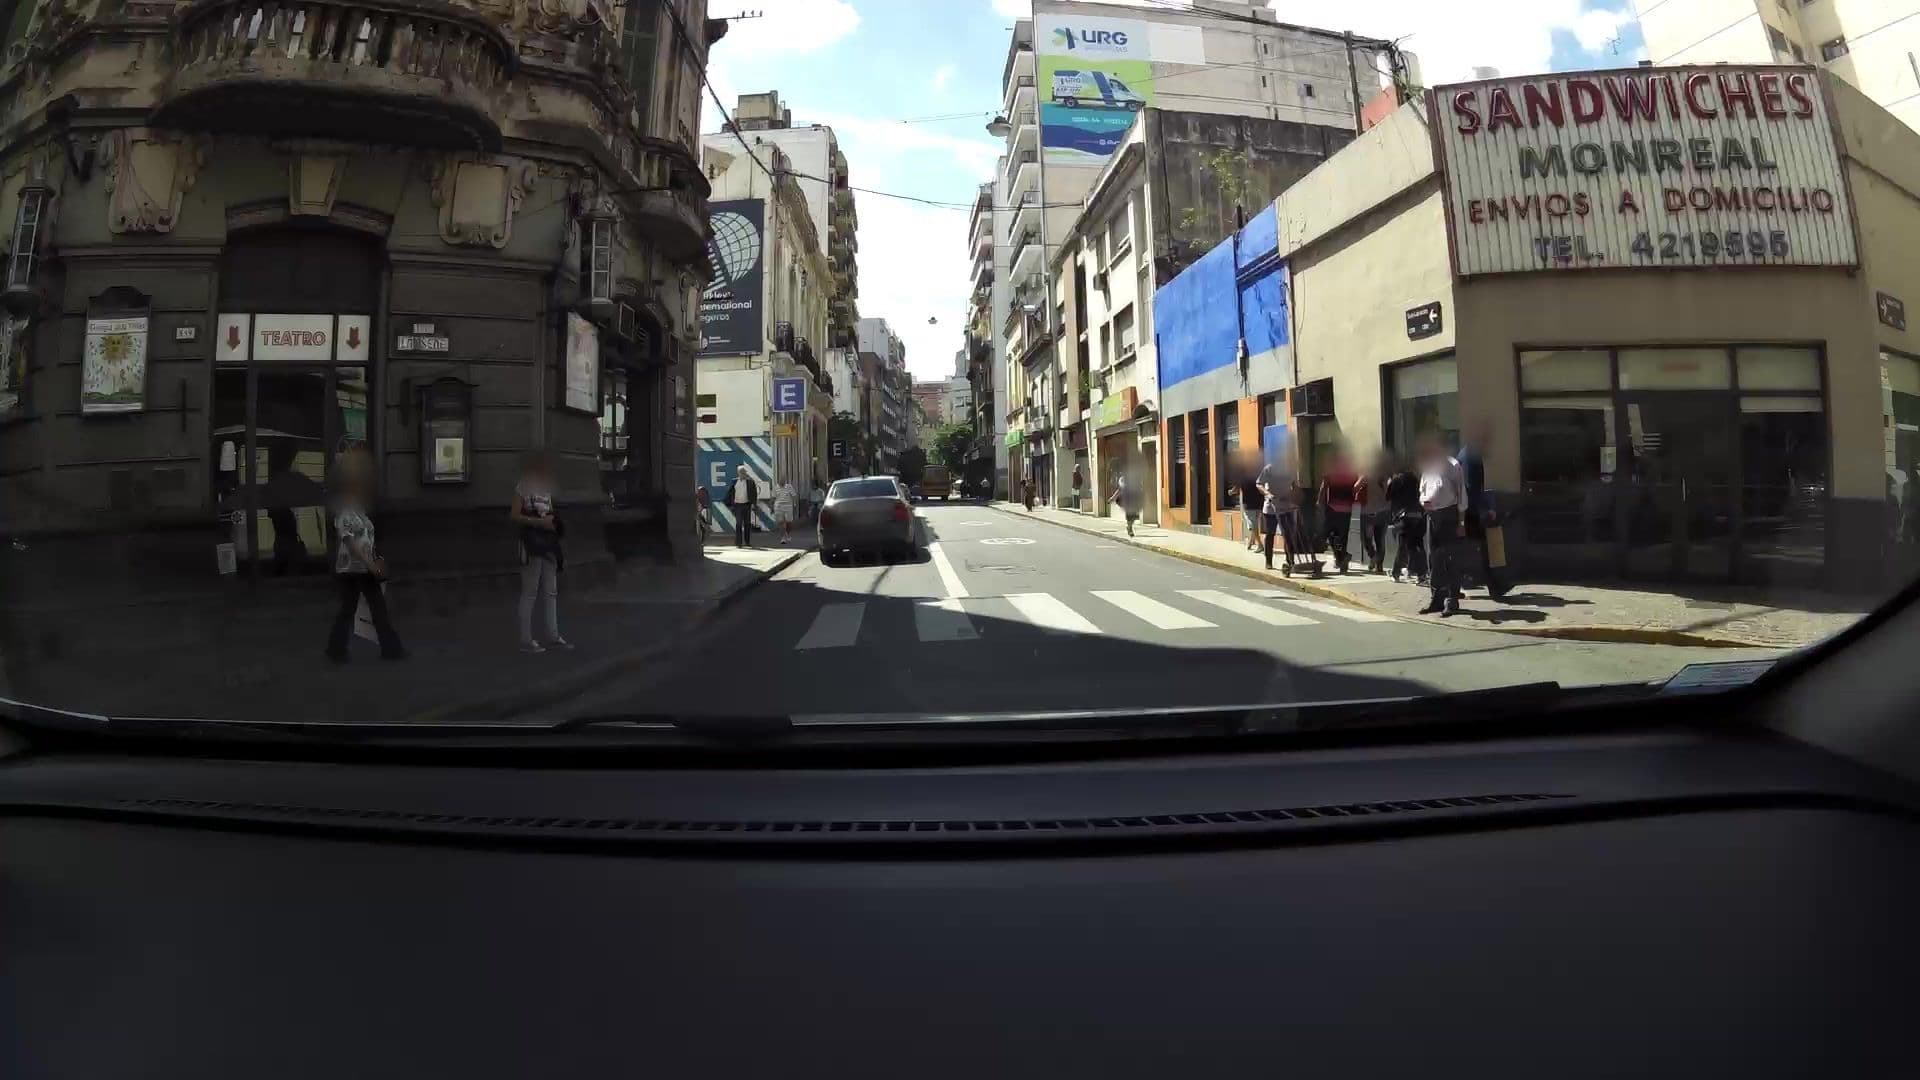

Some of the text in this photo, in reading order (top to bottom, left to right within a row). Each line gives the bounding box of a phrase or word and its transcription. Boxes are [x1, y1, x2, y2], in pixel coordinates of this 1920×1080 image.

[1082, 29, 1128, 46] URG
[1454, 74, 1814, 135] SANDWICHES
[1519, 137, 1778, 179] MONREAL
[1470, 187, 1834, 224] ENVIOS A DOMICILIO
[1535, 230, 1789, 262] TEL. 4219595
[261, 330, 327, 346] TEATRO
[780, 384, 796, 405] E
[832, 442, 841, 456] E
[710, 461, 727, 487] E
